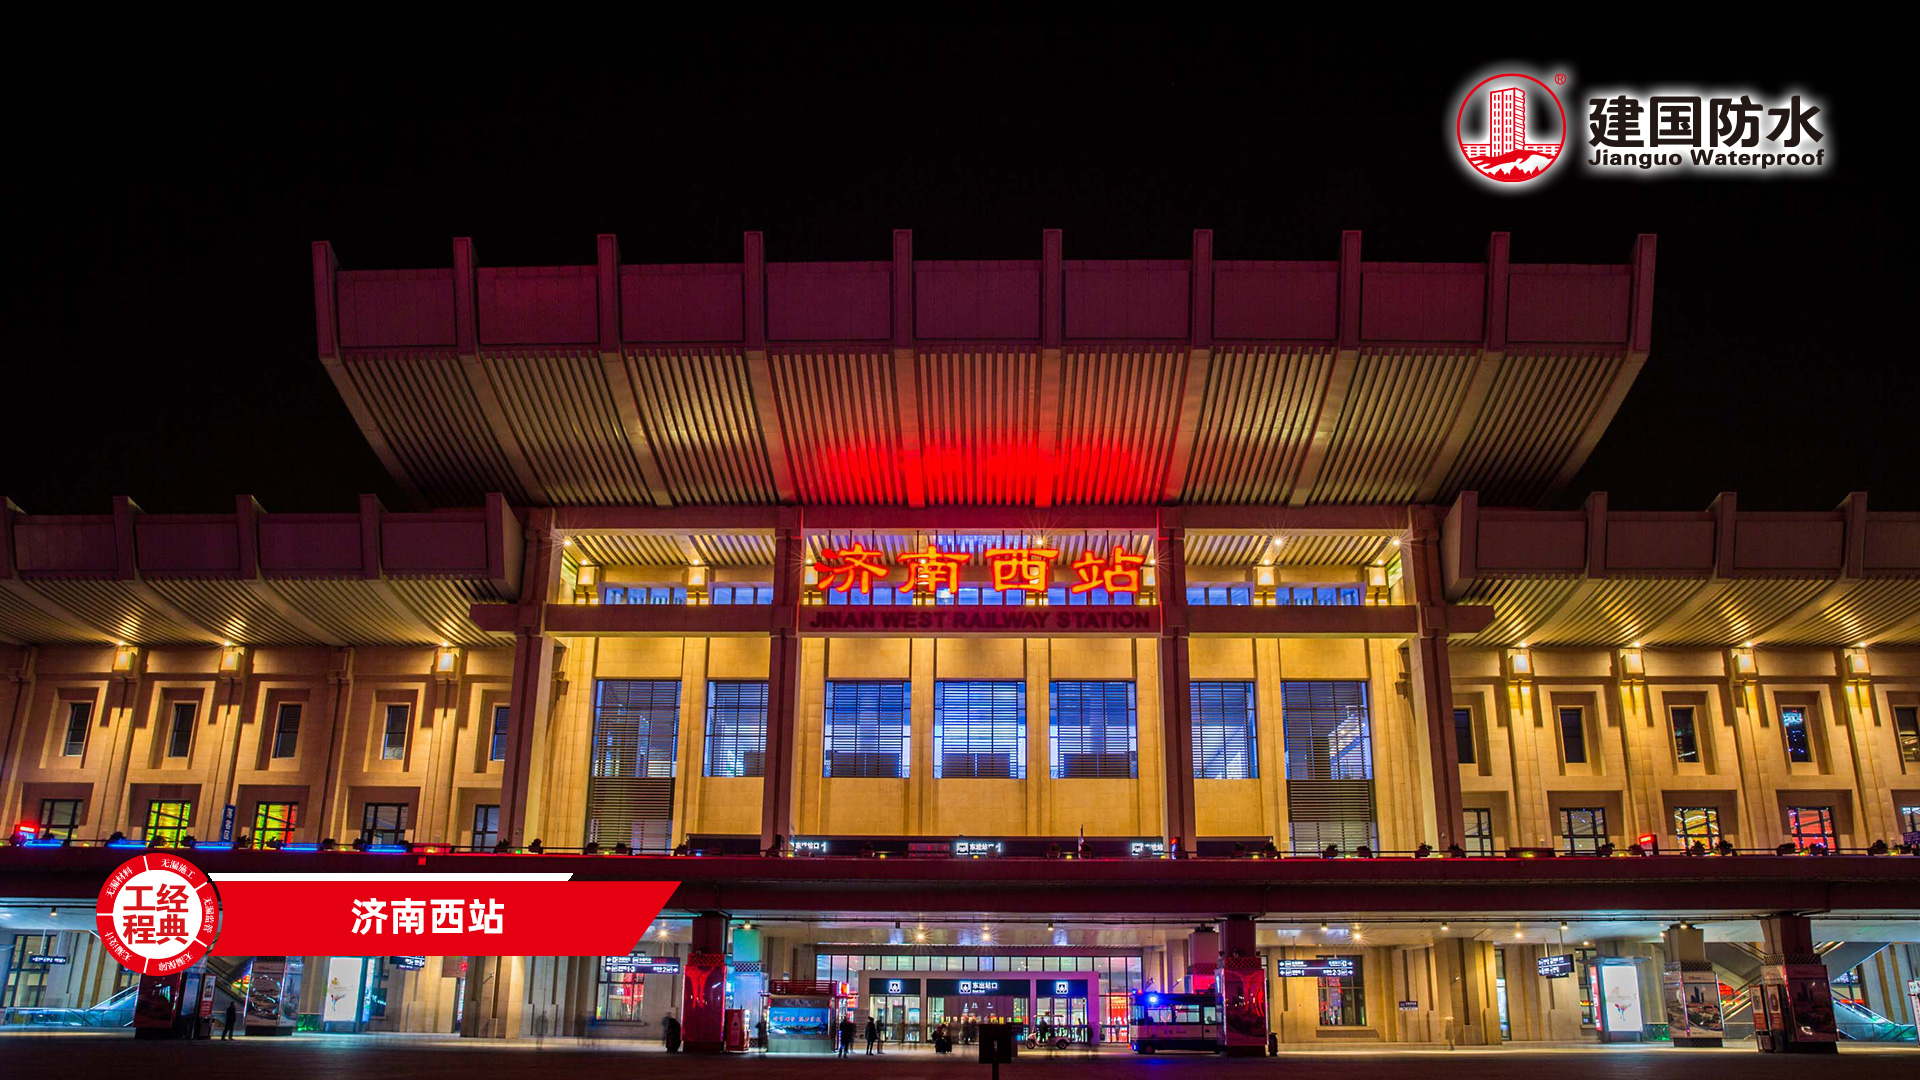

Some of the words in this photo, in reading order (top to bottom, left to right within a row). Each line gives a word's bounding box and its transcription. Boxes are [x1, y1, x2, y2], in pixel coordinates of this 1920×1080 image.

[813, 542, 1145, 595] 济南西站
[810, 611, 875, 628] JINAN
[881, 611, 947, 628] WEST
[952, 611, 1050, 628] RAILWAY
[1056, 611, 1150, 628] STATION
